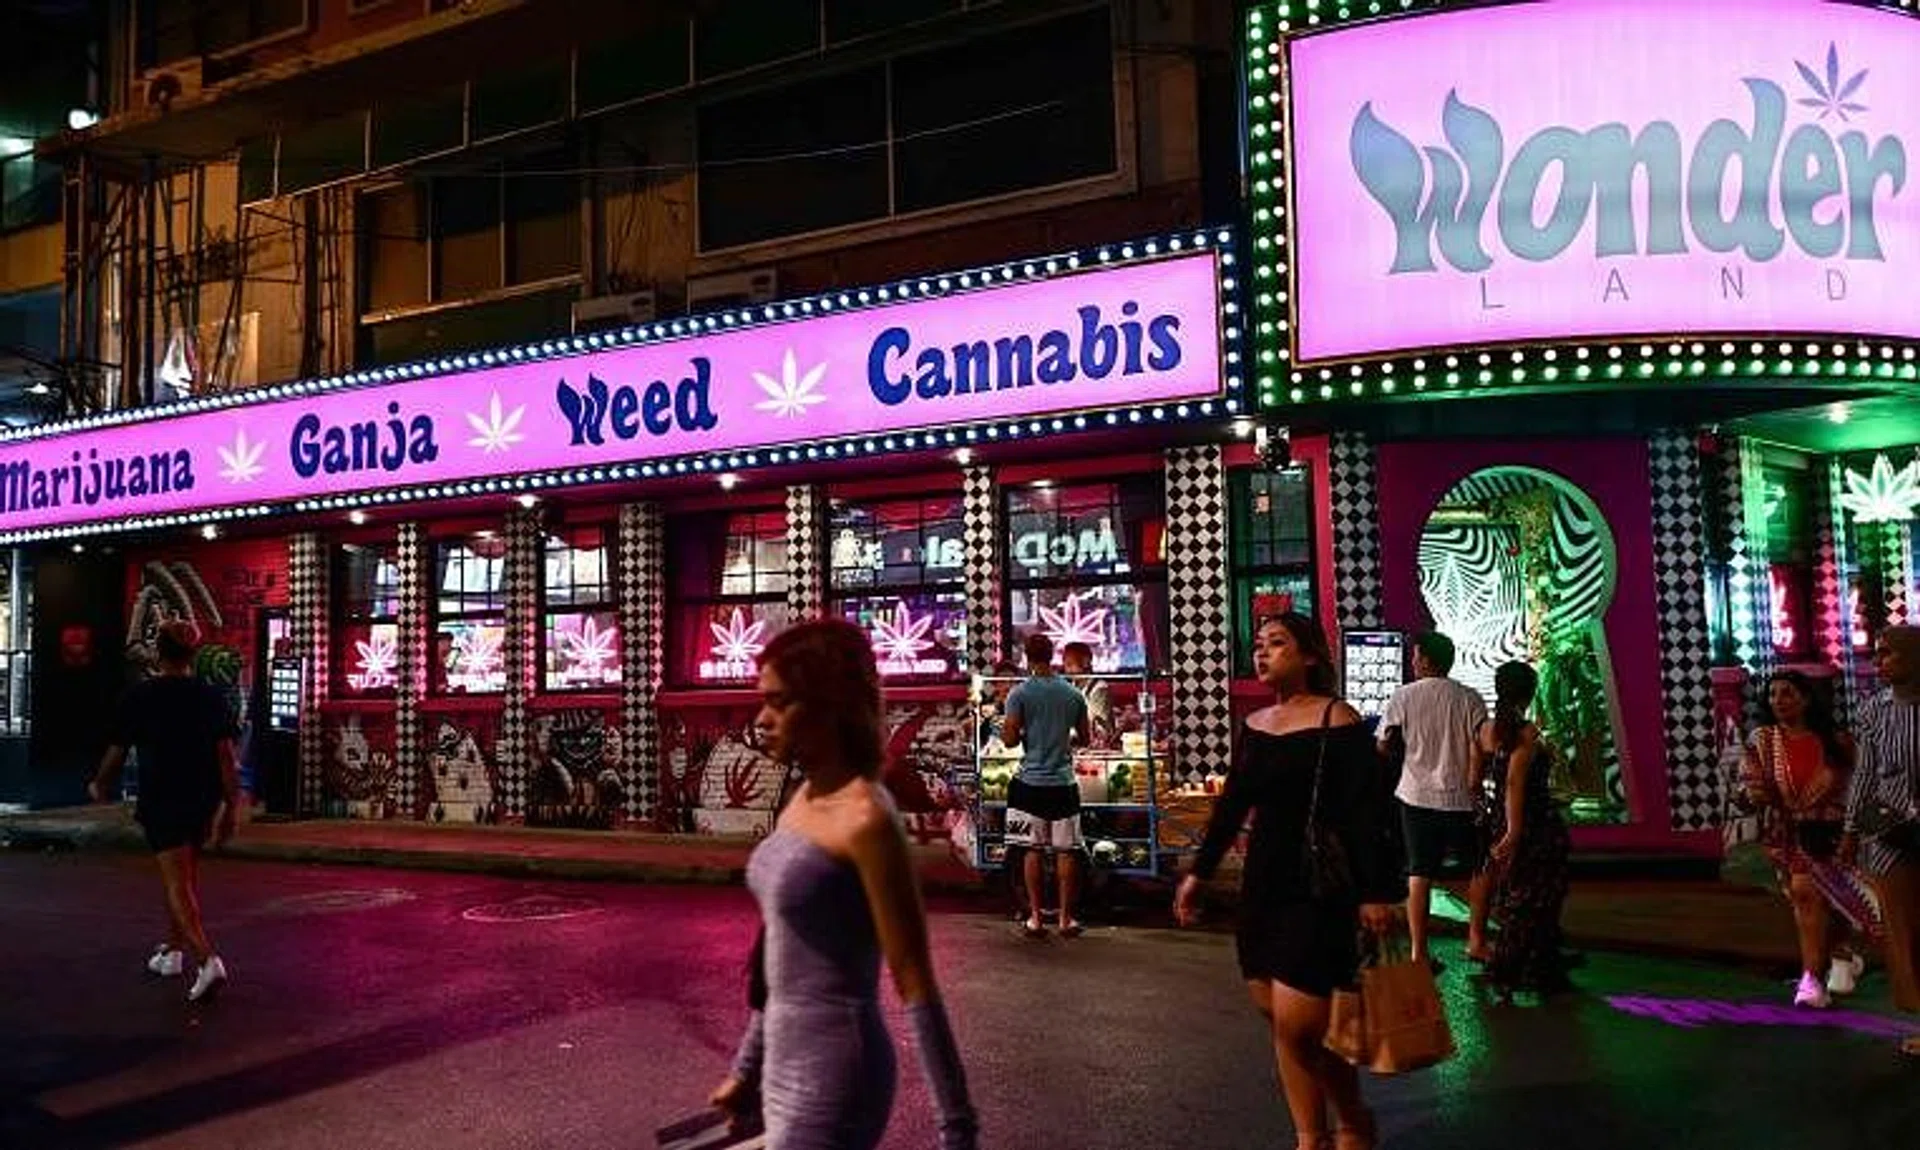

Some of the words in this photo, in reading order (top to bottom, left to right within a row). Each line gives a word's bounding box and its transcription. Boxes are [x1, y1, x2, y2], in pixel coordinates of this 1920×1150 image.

[1350, 77, 1907, 275] Wonder
[1480, 266, 1847, 309] LAND
[0, 448, 195, 513] Marijuana
[289, 402, 438, 478] Ganja
[556, 356, 718, 447] Weed
[868, 301, 1183, 406] Cannabis
